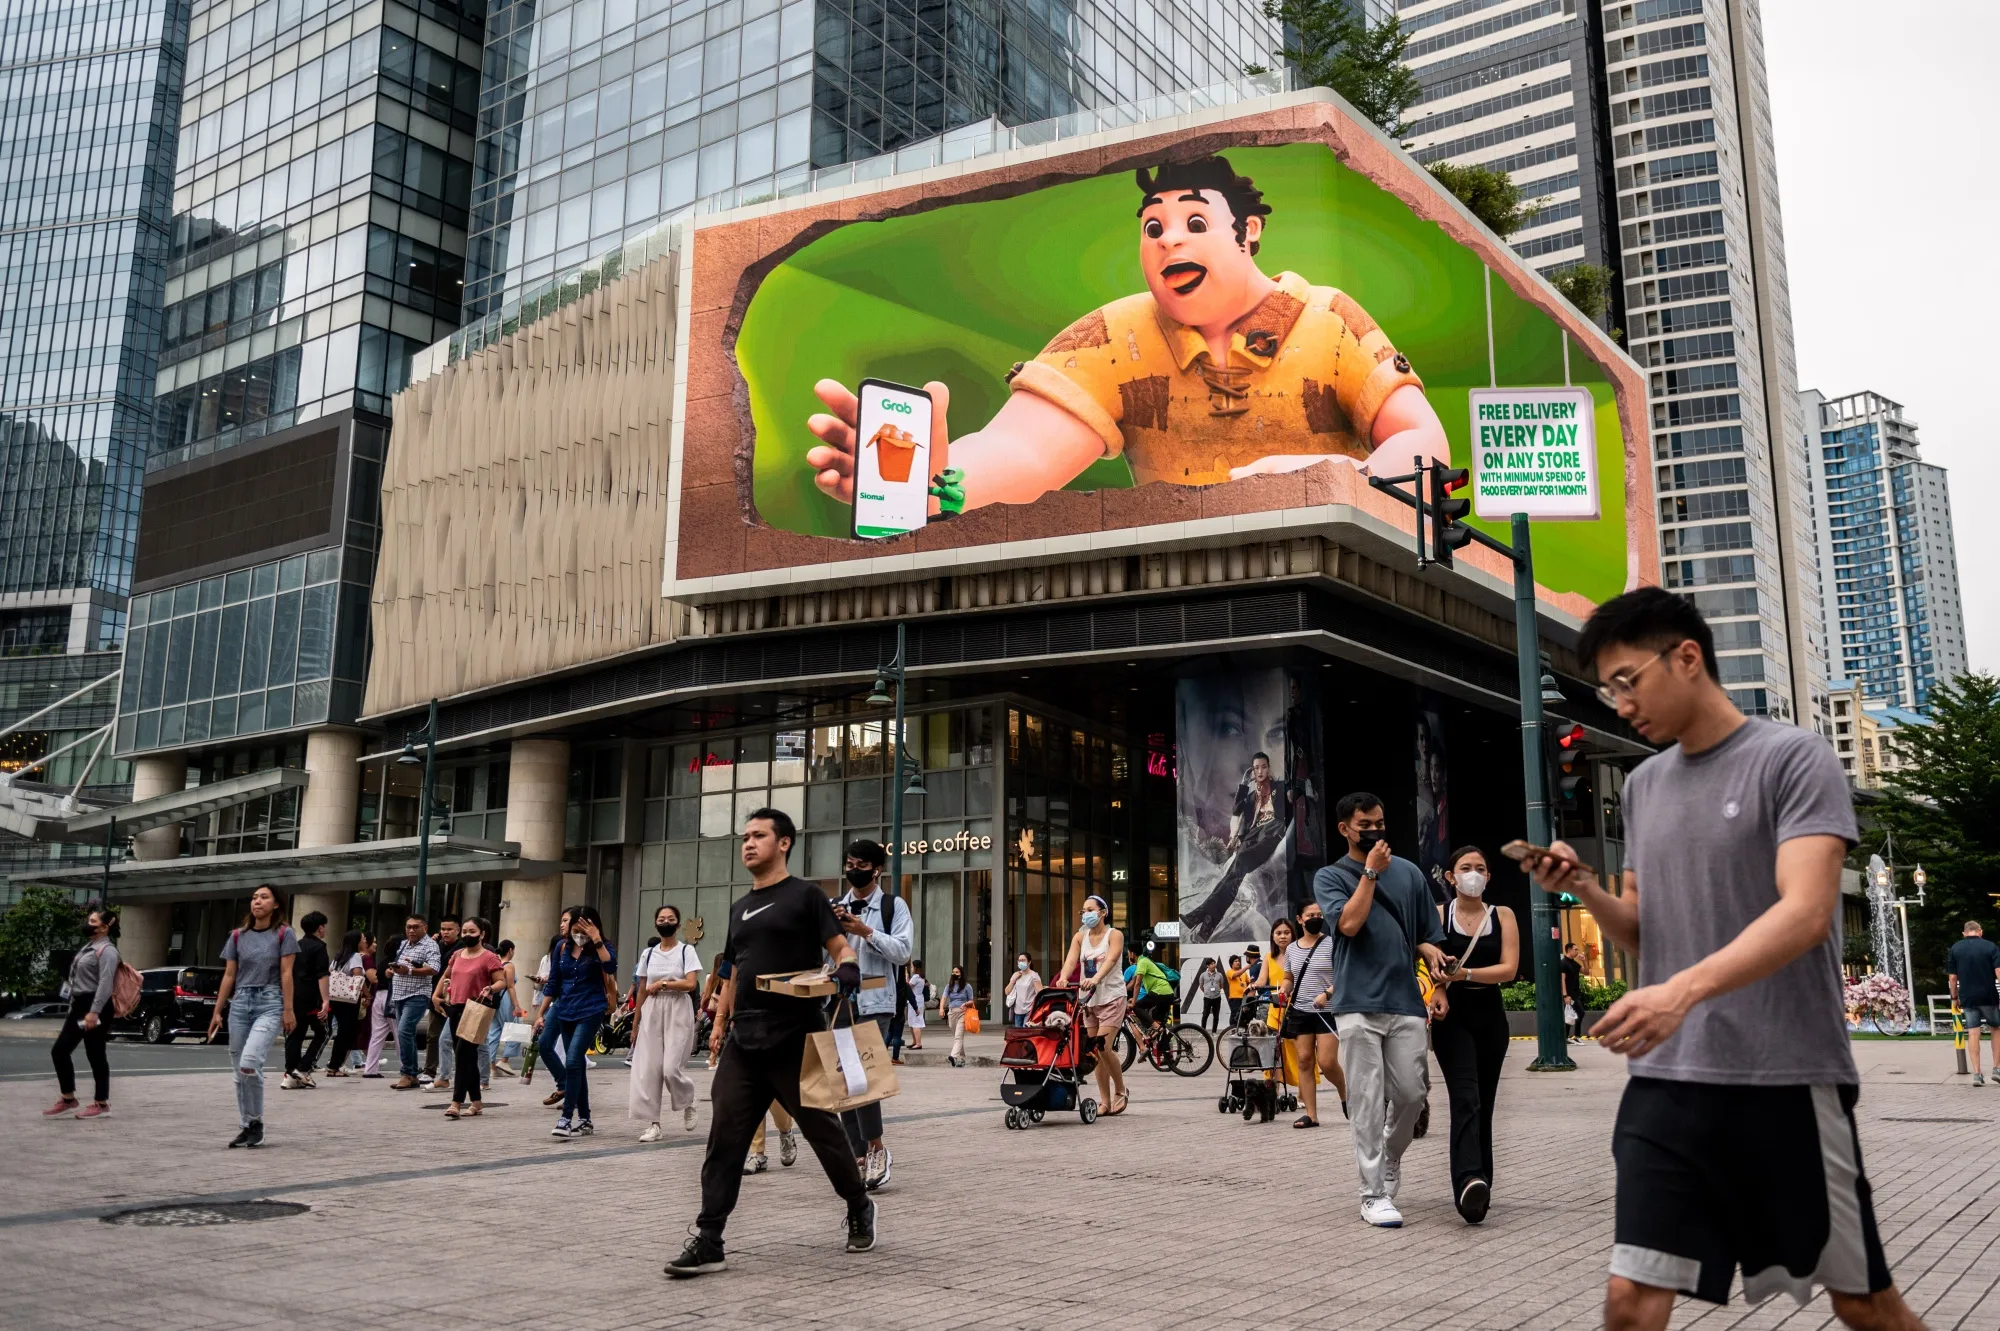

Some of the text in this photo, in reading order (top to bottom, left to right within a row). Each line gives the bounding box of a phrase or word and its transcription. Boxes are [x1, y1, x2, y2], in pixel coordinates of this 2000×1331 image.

[881, 398, 912, 414] Grab
[1478, 402, 1577, 420] FREE DELIVERY
[1480, 424, 1578, 447] EVERY DAY
[1483, 451, 1581, 469] ON ANY STORE
[1480, 471, 1586, 482] WITH MINIMUM SPEND OF
[859, 492, 885, 501] Siomai
[1500, 485, 1523, 496] EVERY
[1523, 485, 1539, 496] DAY
[1539, 485, 1553, 496] FOR
[932, 830, 992, 853] coffee
